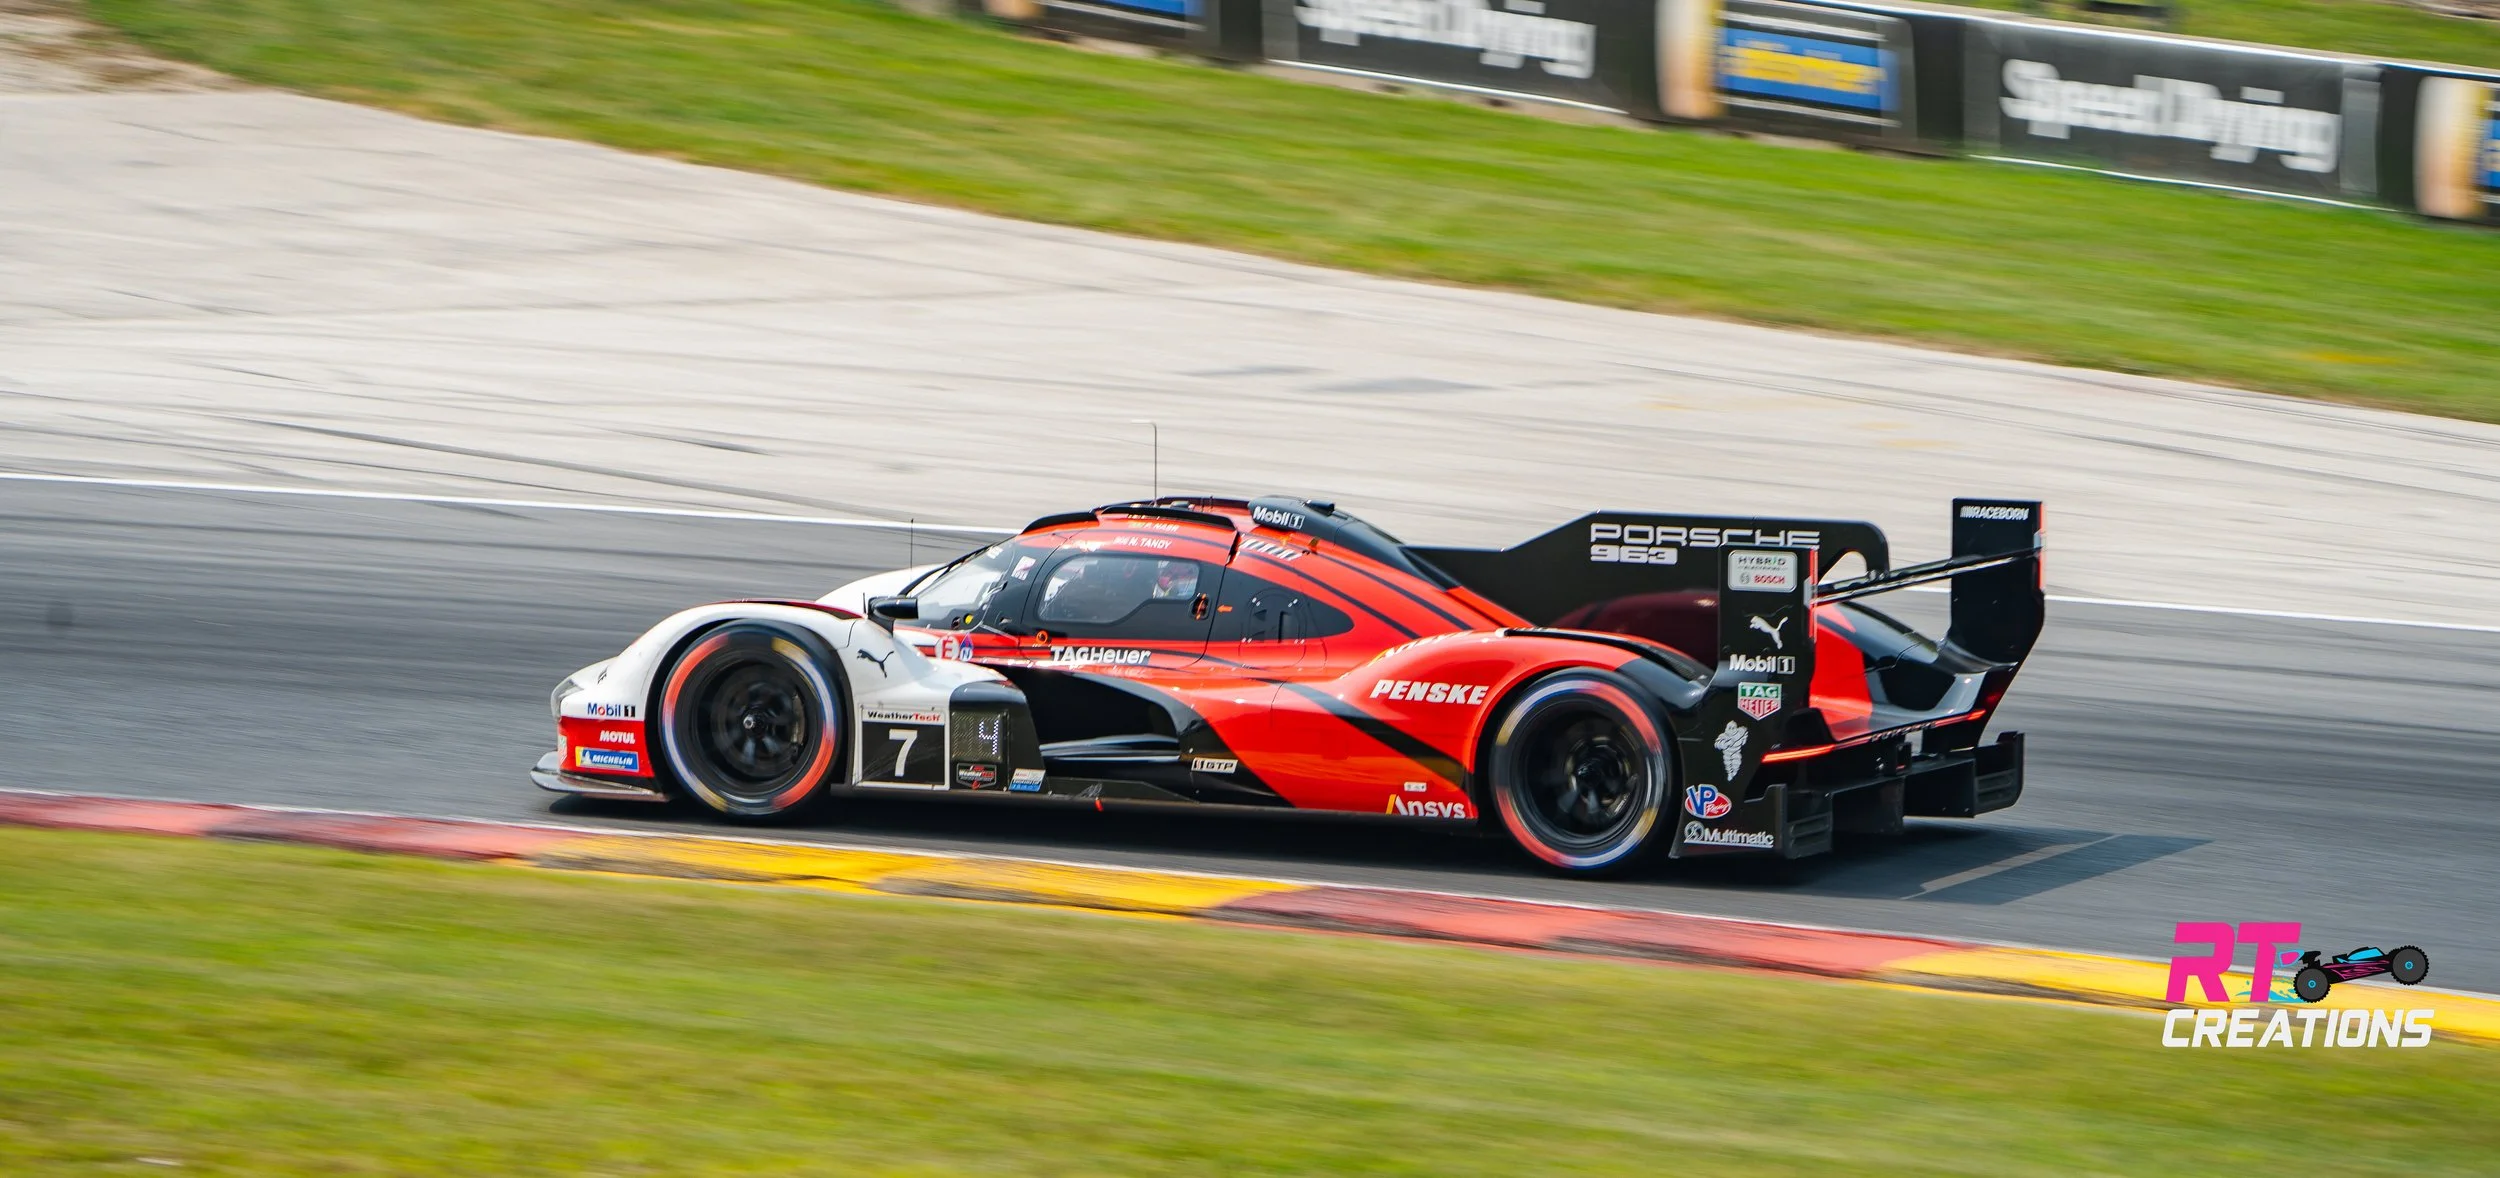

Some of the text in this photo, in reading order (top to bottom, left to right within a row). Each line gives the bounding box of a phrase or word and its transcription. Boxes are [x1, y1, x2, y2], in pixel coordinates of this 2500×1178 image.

[1252, 506, 1291, 526] Mobil
[1971, 506, 2029, 520] RACEBORN
[1140, 538, 1172, 550] TANDY
[1590, 523, 1820, 549] PORSCHE
[1590, 544, 1678, 565] 963
[1753, 574, 1786, 584] BOSCH
[1729, 653, 1777, 673] Mobil
[1369, 679, 1489, 706] PENSKE
[1741, 686, 1778, 698] TAG
[587, 702, 621, 717] Mobil
[867, 711, 941, 722] WeatherTech
[1740, 699, 1779, 718] HEUER
[599, 730, 636, 745] MOTUL
[978, 719, 999, 755] 4
[592, 754, 634, 766] MICHELIN
[888, 728, 918, 777] 7
[1688, 786, 1716, 816] VP
[1704, 827, 1774, 845] Multimatic
